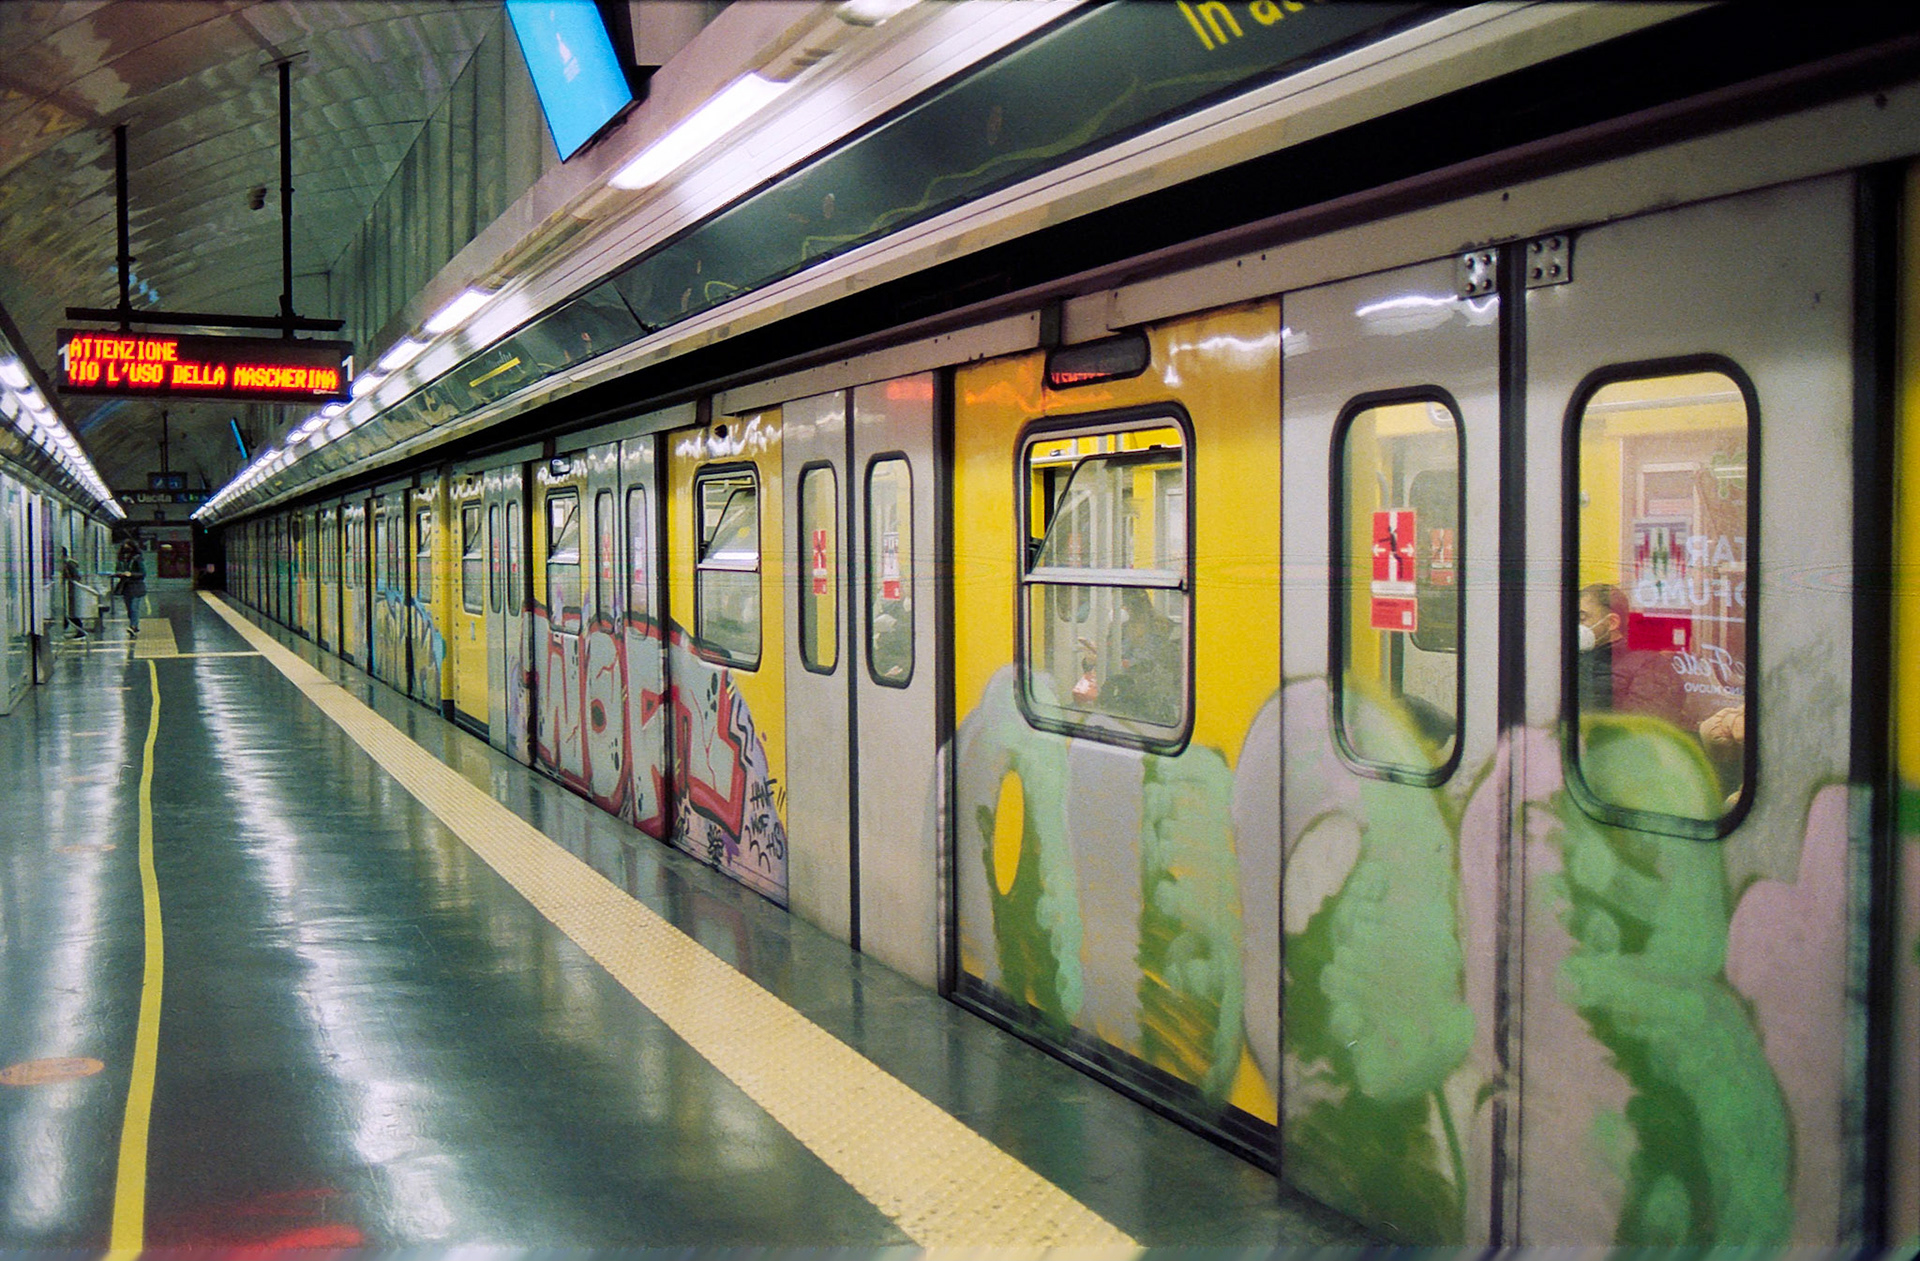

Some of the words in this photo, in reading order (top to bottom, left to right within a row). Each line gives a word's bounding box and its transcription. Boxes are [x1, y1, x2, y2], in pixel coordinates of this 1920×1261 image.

[1176, 0, 1243, 50] In
[57, 343, 70, 372] 1
[69, 337, 178, 361] ATTENZIONE
[107, 361, 163, 383] L'USO
[171, 363, 227, 386] DELLA
[232, 365, 338, 390] MASCHERINA
[341, 354, 354, 382] 1
